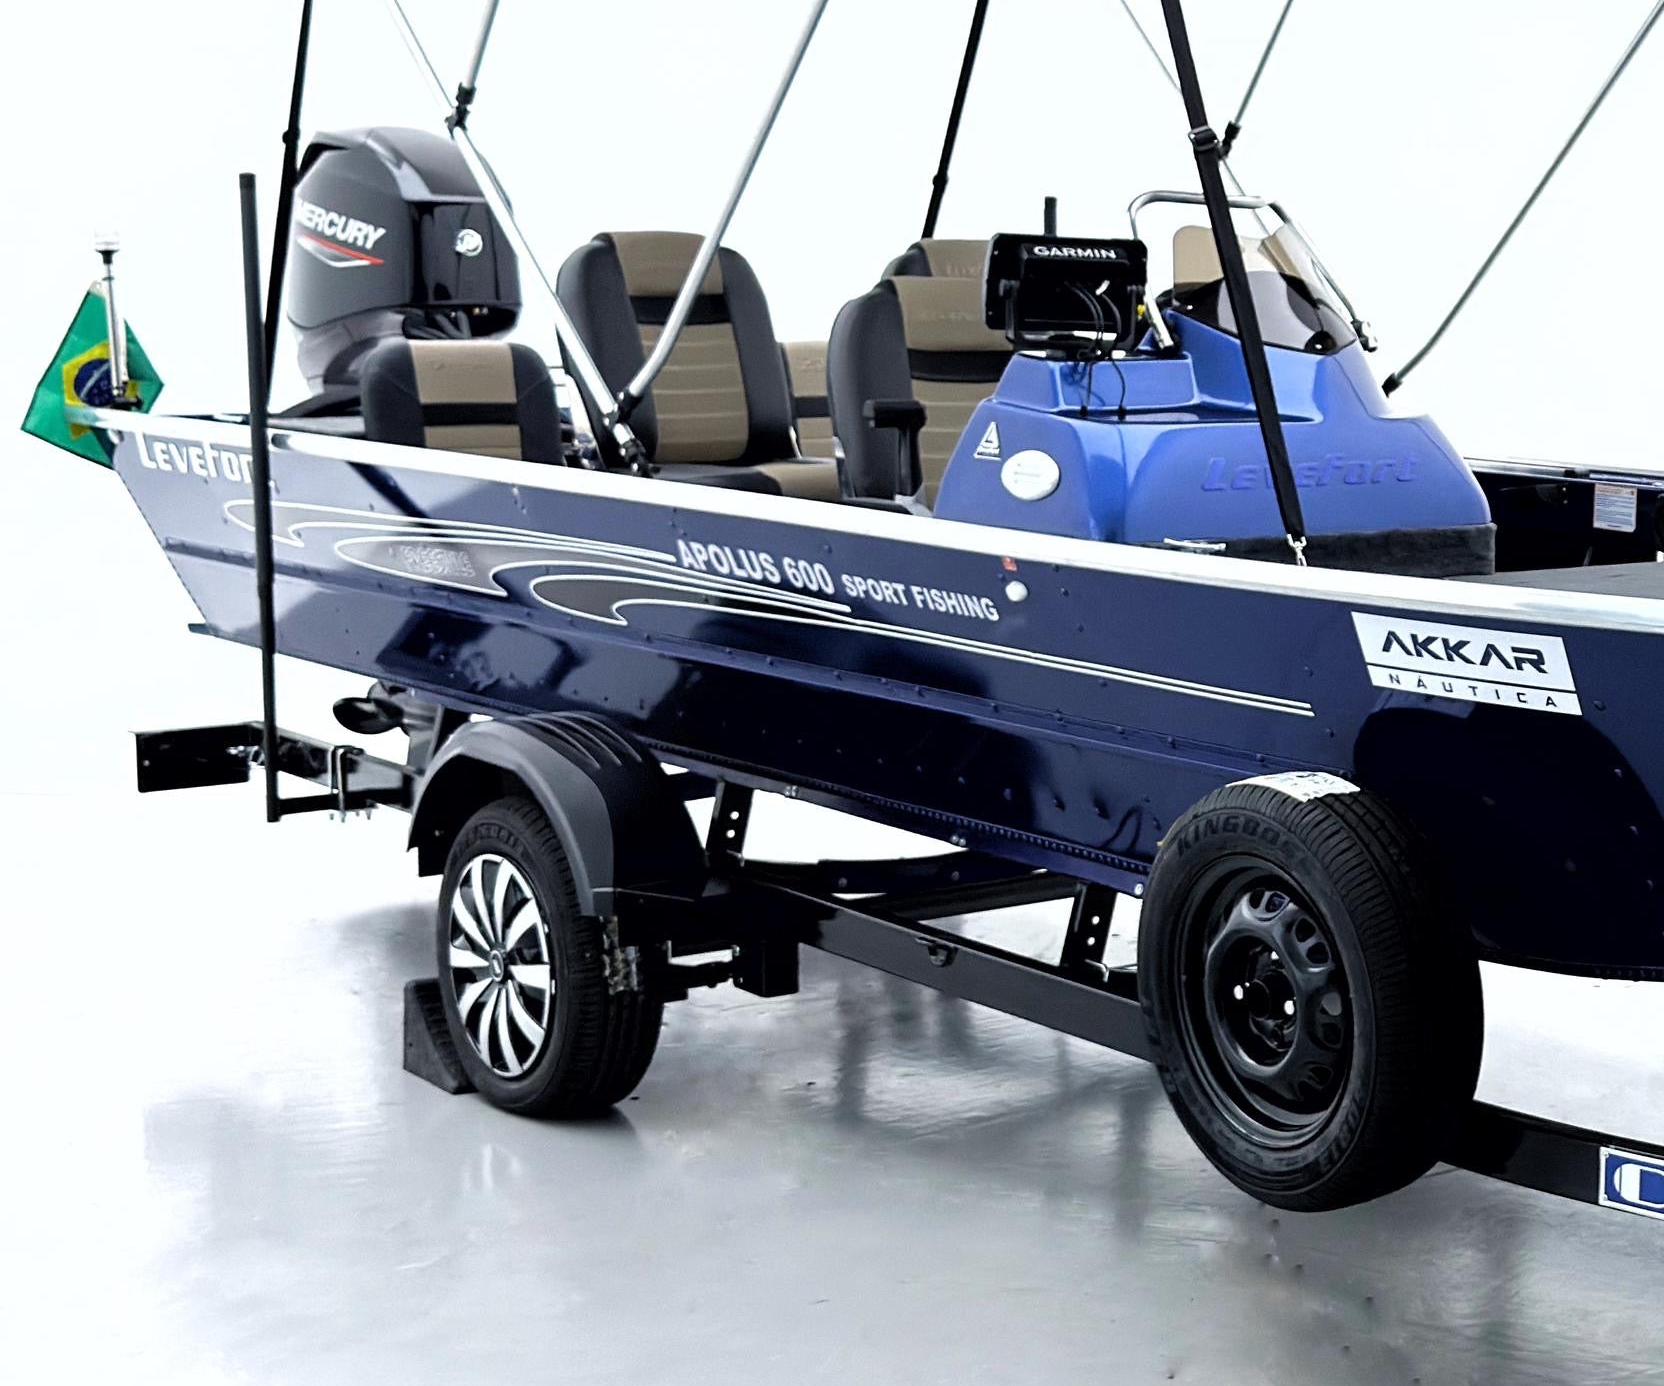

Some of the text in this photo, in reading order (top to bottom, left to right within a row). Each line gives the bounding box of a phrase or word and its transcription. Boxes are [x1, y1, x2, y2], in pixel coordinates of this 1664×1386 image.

[1033, 246, 1117, 259] GARMIN
[676, 539, 1000, 622] APOLUS 600 SPORT FISHING
[1382, 630, 1549, 674] AKKAR
